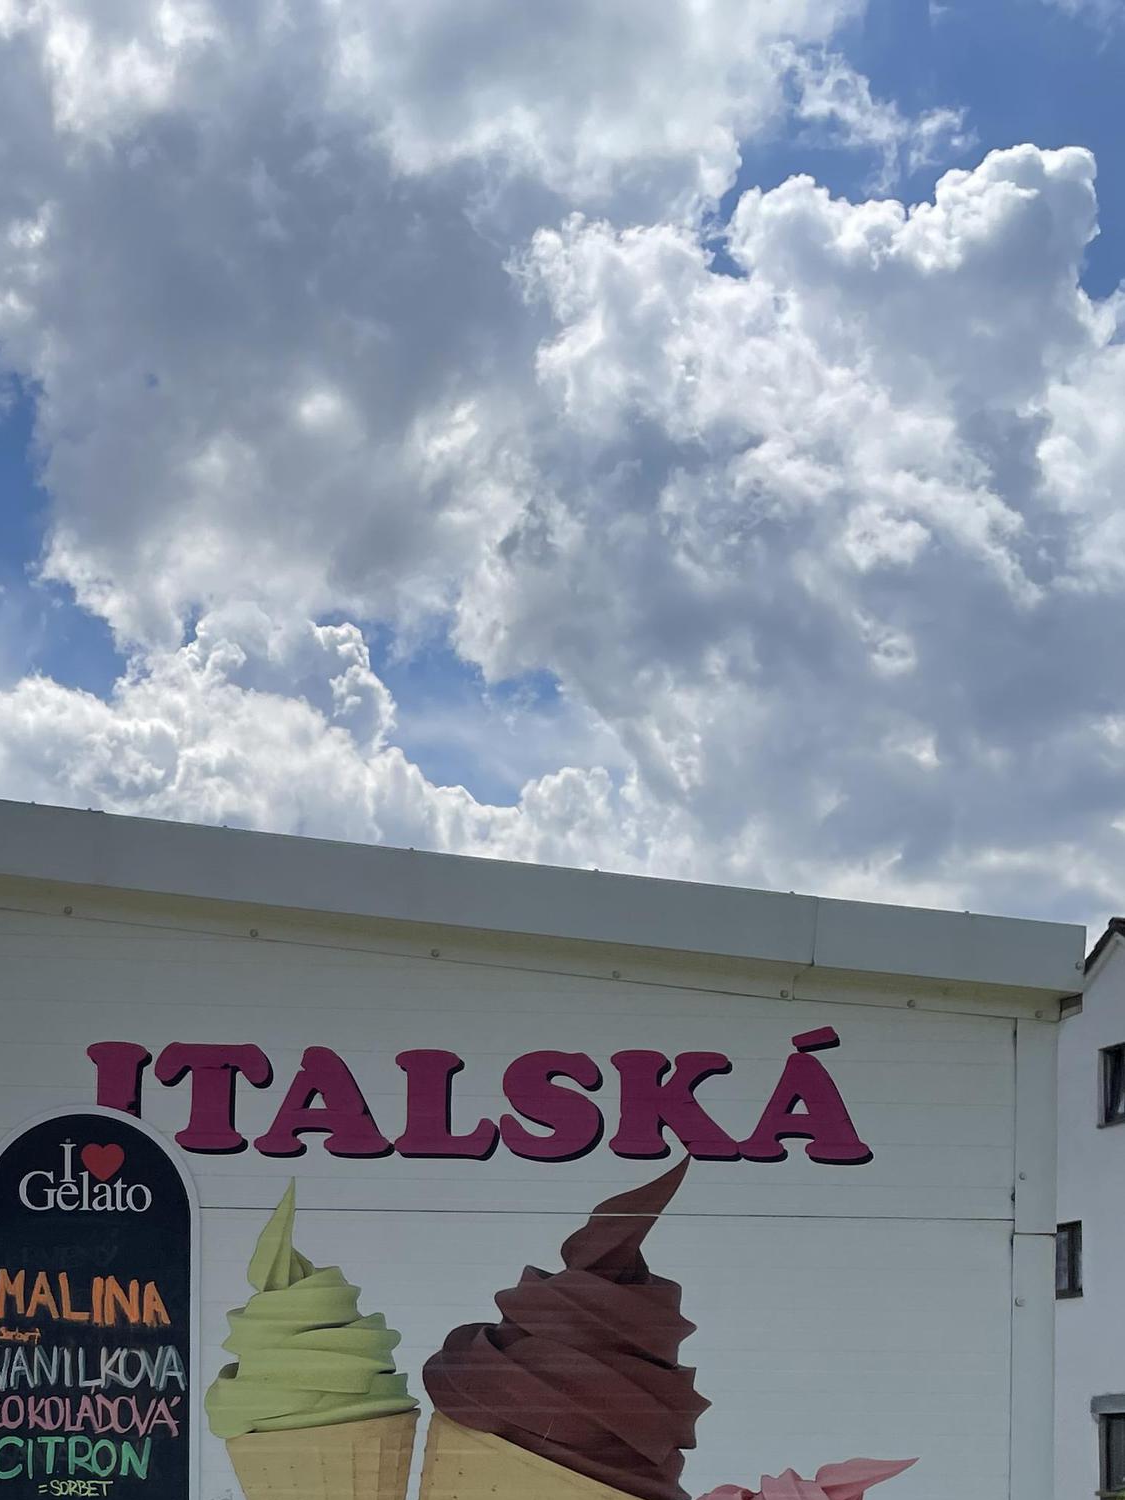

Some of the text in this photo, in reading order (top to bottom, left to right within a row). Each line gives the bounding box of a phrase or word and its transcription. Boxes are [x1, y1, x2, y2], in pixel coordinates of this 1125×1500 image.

[86, 1026, 873, 1165] ITALSKÁ
[59, 1141, 77, 1183] I
[19, 1169, 153, 1213] Gelato
